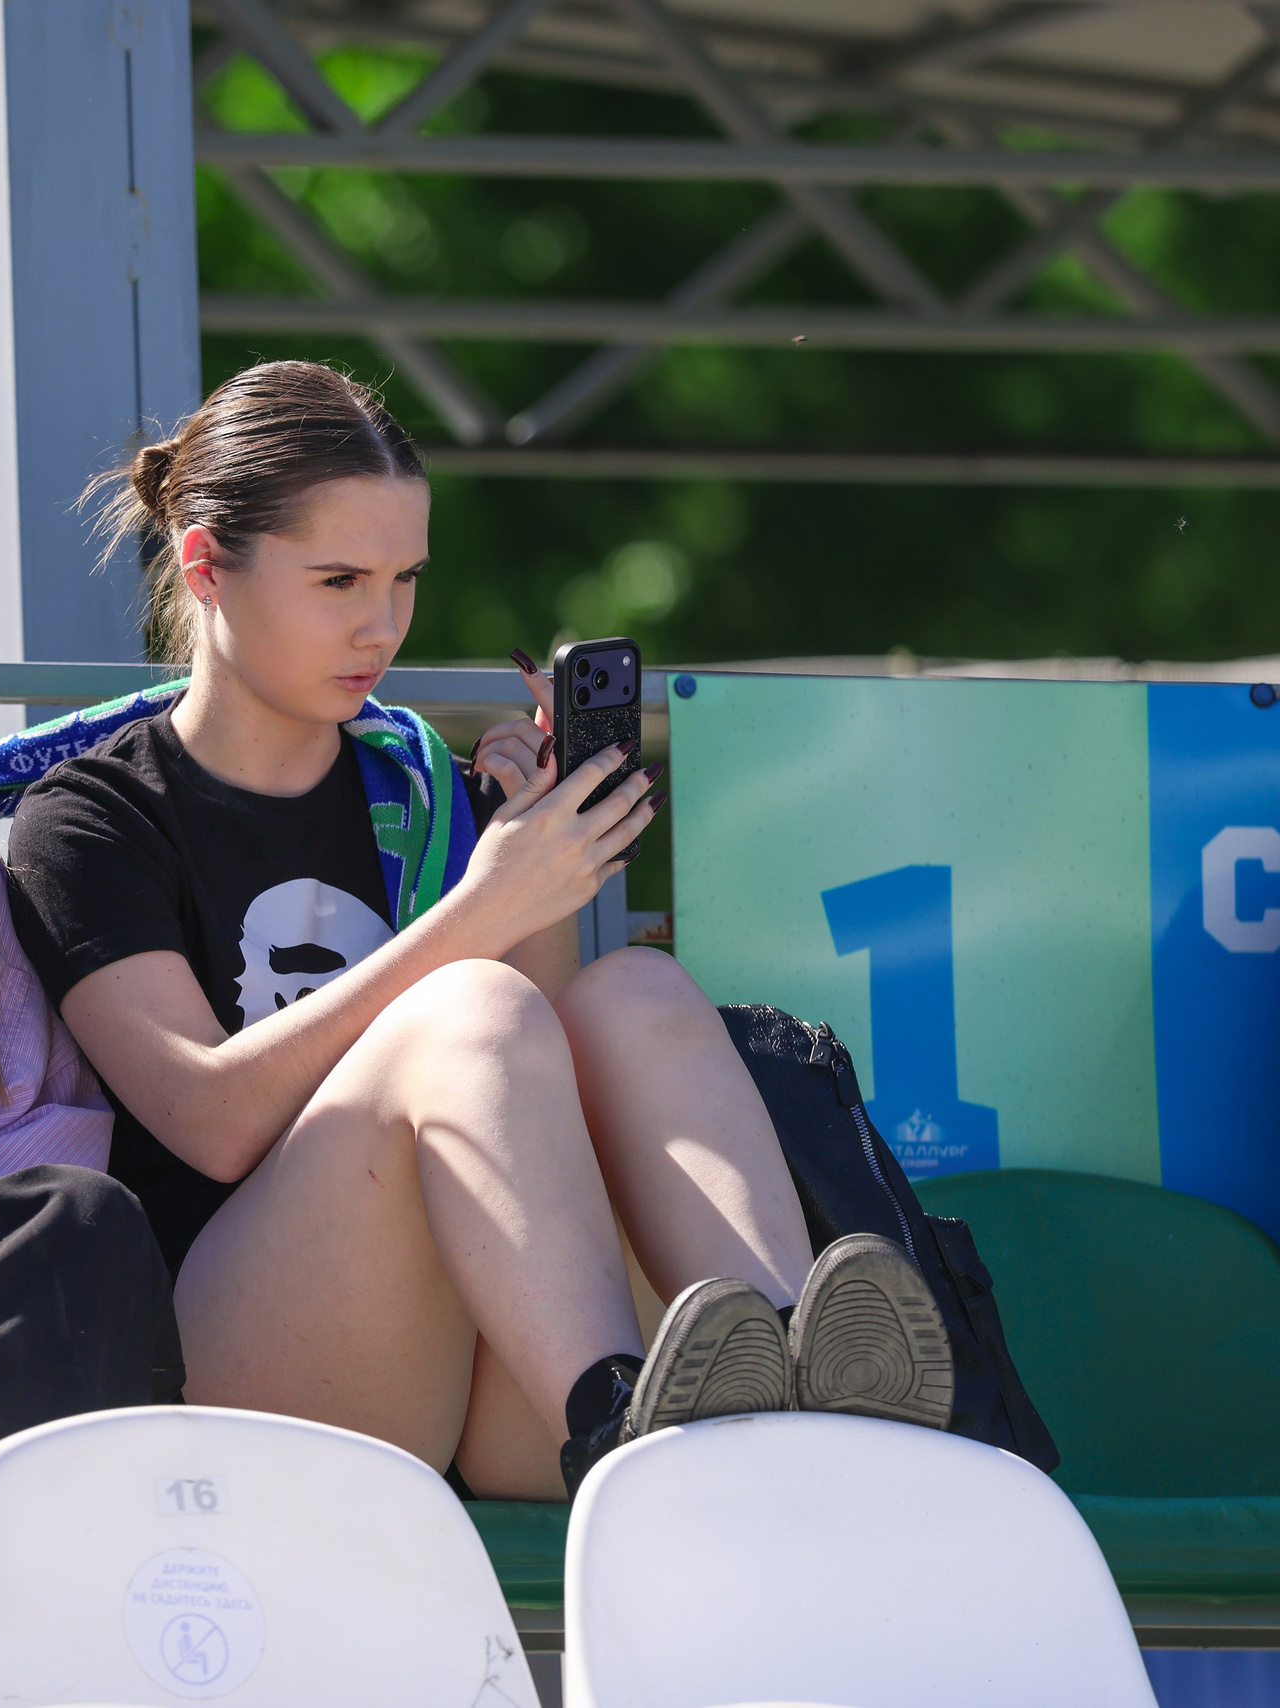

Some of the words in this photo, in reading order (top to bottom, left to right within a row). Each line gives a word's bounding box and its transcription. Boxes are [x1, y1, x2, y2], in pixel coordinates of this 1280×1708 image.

[821, 864, 1000, 1177] 1
[893, 1144, 968, 1158] ТАЛЛУРГ
[166, 1479, 219, 1511] 16
[162, 1563, 220, 1577] ДЕРЖИТЕ
[150, 1594, 212, 1607] САДИТЕСЬ
[216, 1598, 253, 1610] ЗДЕСЬ
